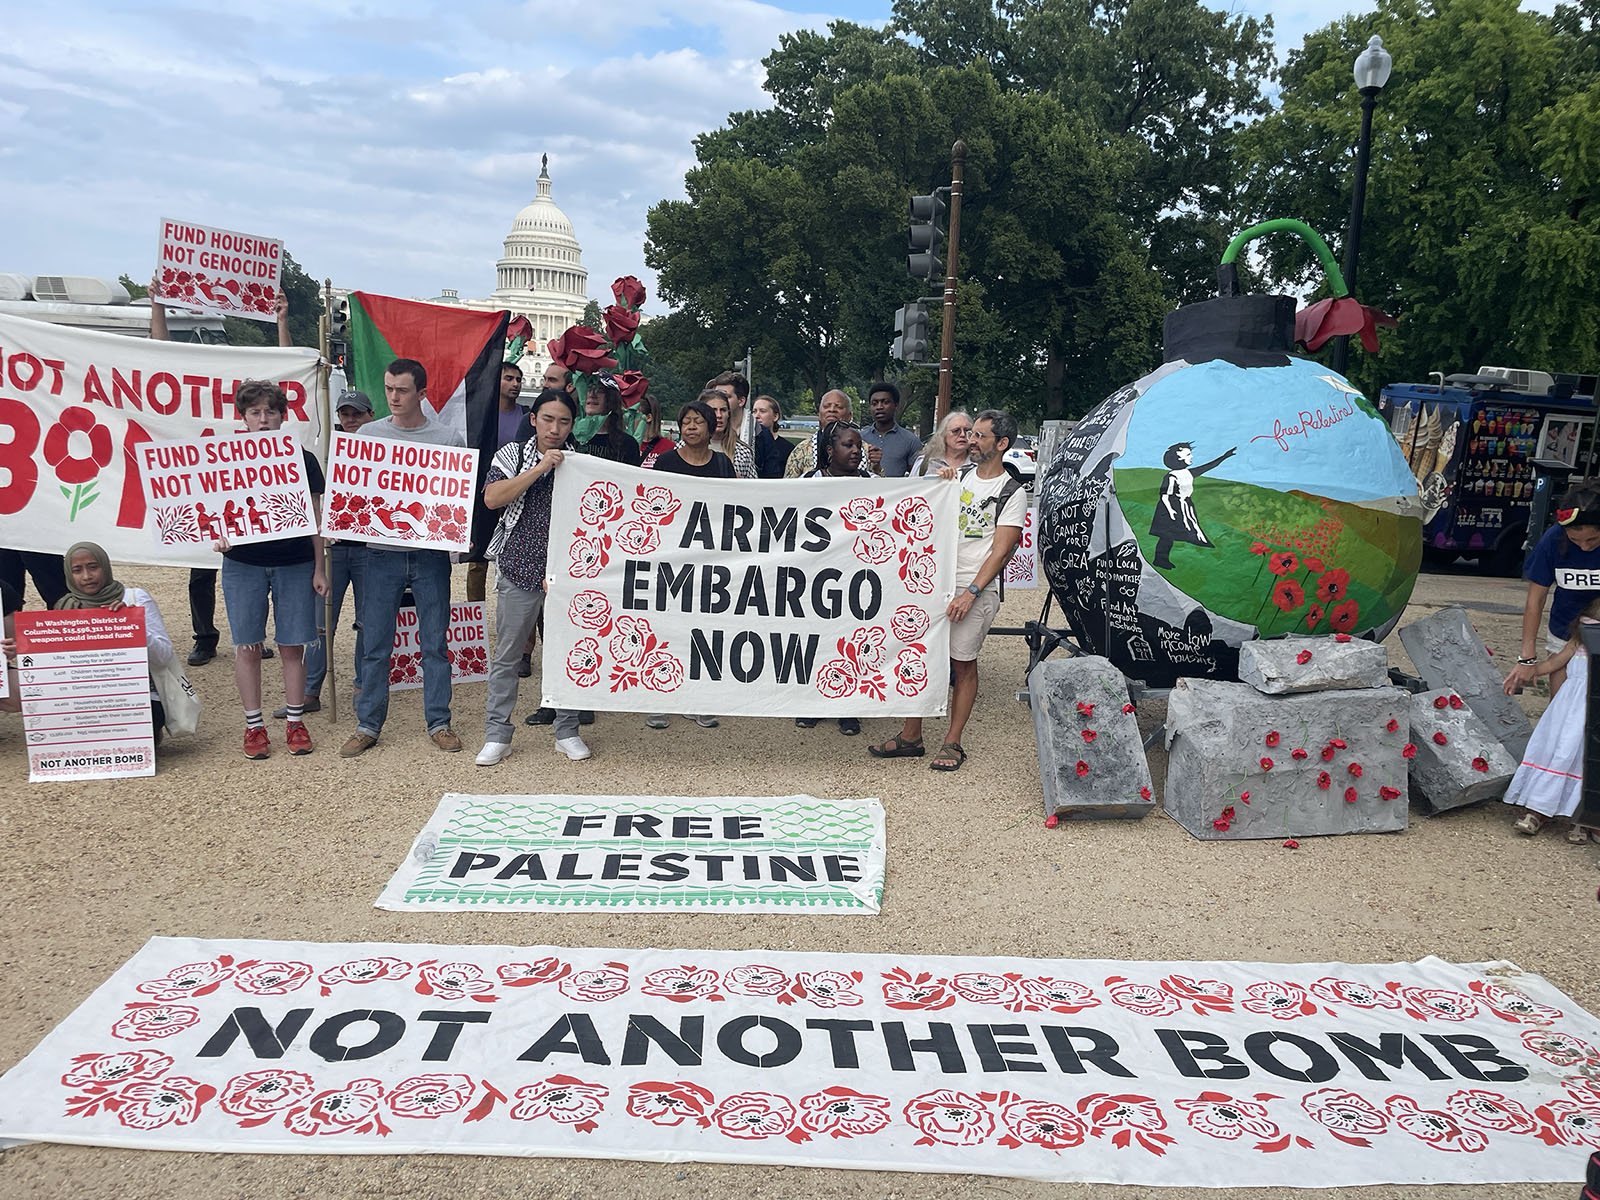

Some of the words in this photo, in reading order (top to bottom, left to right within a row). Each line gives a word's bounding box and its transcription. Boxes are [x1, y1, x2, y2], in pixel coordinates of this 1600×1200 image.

[164, 222, 206, 245] FUND
[210, 232, 279, 259] HOUSING
[163, 244, 195, 265] NOT
[200, 251, 277, 280] GENOCIDE
[0, 347, 64, 395] OT
[83, 364, 310, 422] ANOTHR
[144, 445, 200, 470] FUND
[205, 436, 295, 464] SCHOOLS
[336, 437, 386, 463] FUND
[392, 446, 473, 473] HOUSING
[150, 474, 191, 499] NOT
[198, 462, 300, 493] WEAPONS
[332, 464, 372, 487] NOT
[378, 470, 470, 499] GENOCIDE
[1537, 478, 1544, 489] P
[1062, 504, 1080, 520] NOT
[678, 501, 834, 553] ARMS
[1053, 521, 1087, 543] GRAVES
[1066, 538, 1081, 548] FOR
[1060, 548, 1089, 571] GAZA
[1116, 559, 1138, 571] LOCAL
[622, 559, 883, 621] EMBARGO
[397, 611, 417, 627] ND
[451, 605, 482, 622] SING
[1100, 598, 1120, 611] Fnd
[30, 636, 64, 644] weapons
[393, 631, 410, 648] OT
[1158, 626, 1181, 641] More
[690, 628, 820, 685] NOW
[1160, 639, 1205, 656] income
[40, 760, 61, 769] NOT
[64, 756, 112, 768] ANOTHER
[115, 755, 144, 764] BOMB
[562, 814, 765, 840] FREE
[448, 850, 863, 883] PALESTINE
[195, 1006, 491, 1062] NOT
[515, 1012, 1138, 1079] ANOTHER
[1154, 1029, 1532, 1083] BOMB
